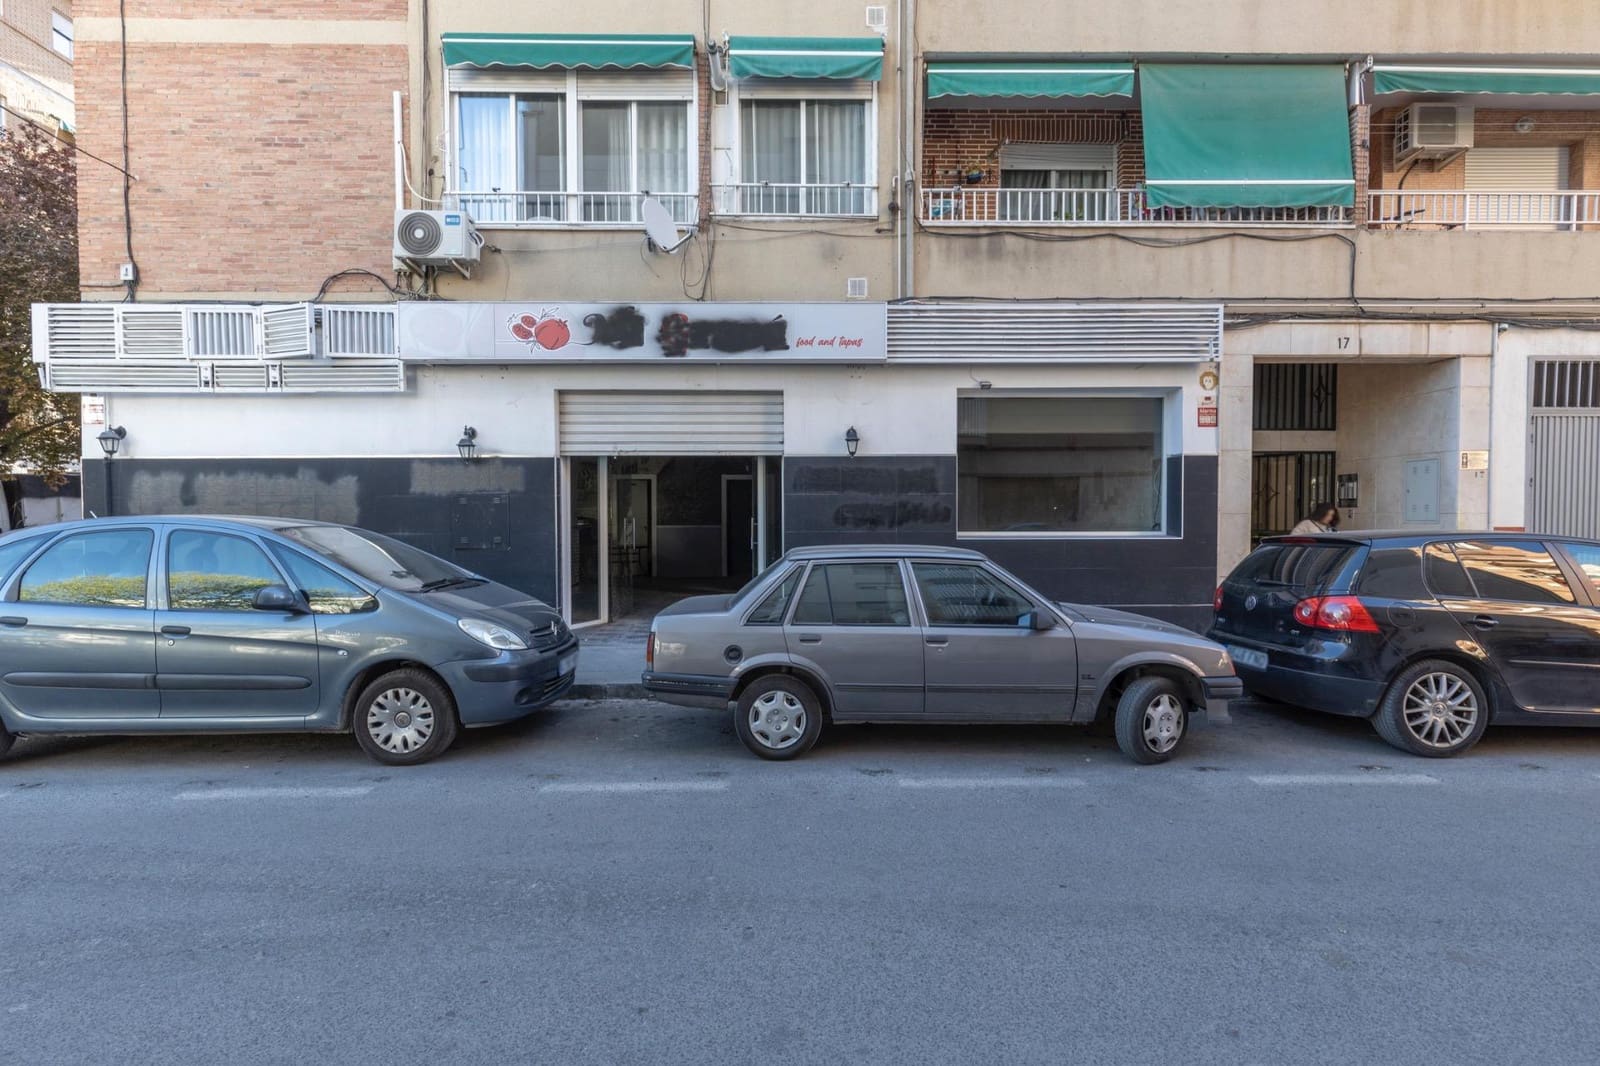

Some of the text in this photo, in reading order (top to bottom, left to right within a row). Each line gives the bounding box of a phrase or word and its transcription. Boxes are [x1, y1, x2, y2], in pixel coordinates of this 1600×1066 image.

[796, 336, 863, 349] food and tapas
[1338, 337, 1350, 349] 17
